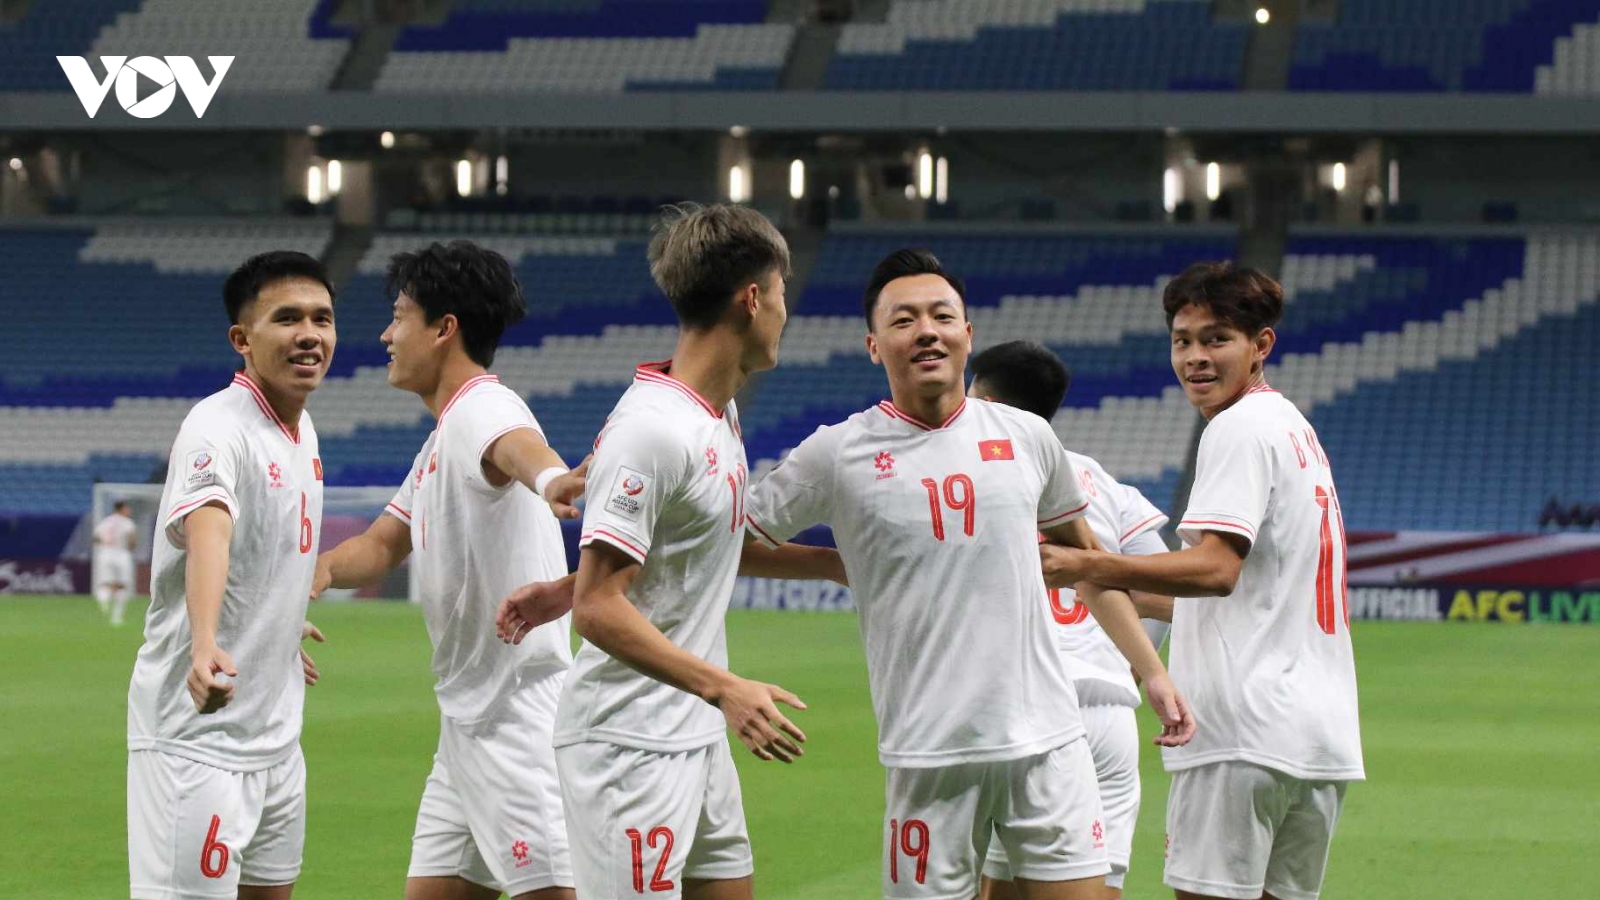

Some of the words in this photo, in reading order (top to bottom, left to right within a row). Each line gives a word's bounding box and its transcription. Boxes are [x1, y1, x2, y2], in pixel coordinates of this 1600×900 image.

[300, 491, 312, 553] 6
[921, 473, 975, 541] 19
[1448, 590, 1525, 622] AFC
[201, 814, 228, 878] 6
[625, 825, 675, 894] 12
[890, 818, 930, 885] 19
